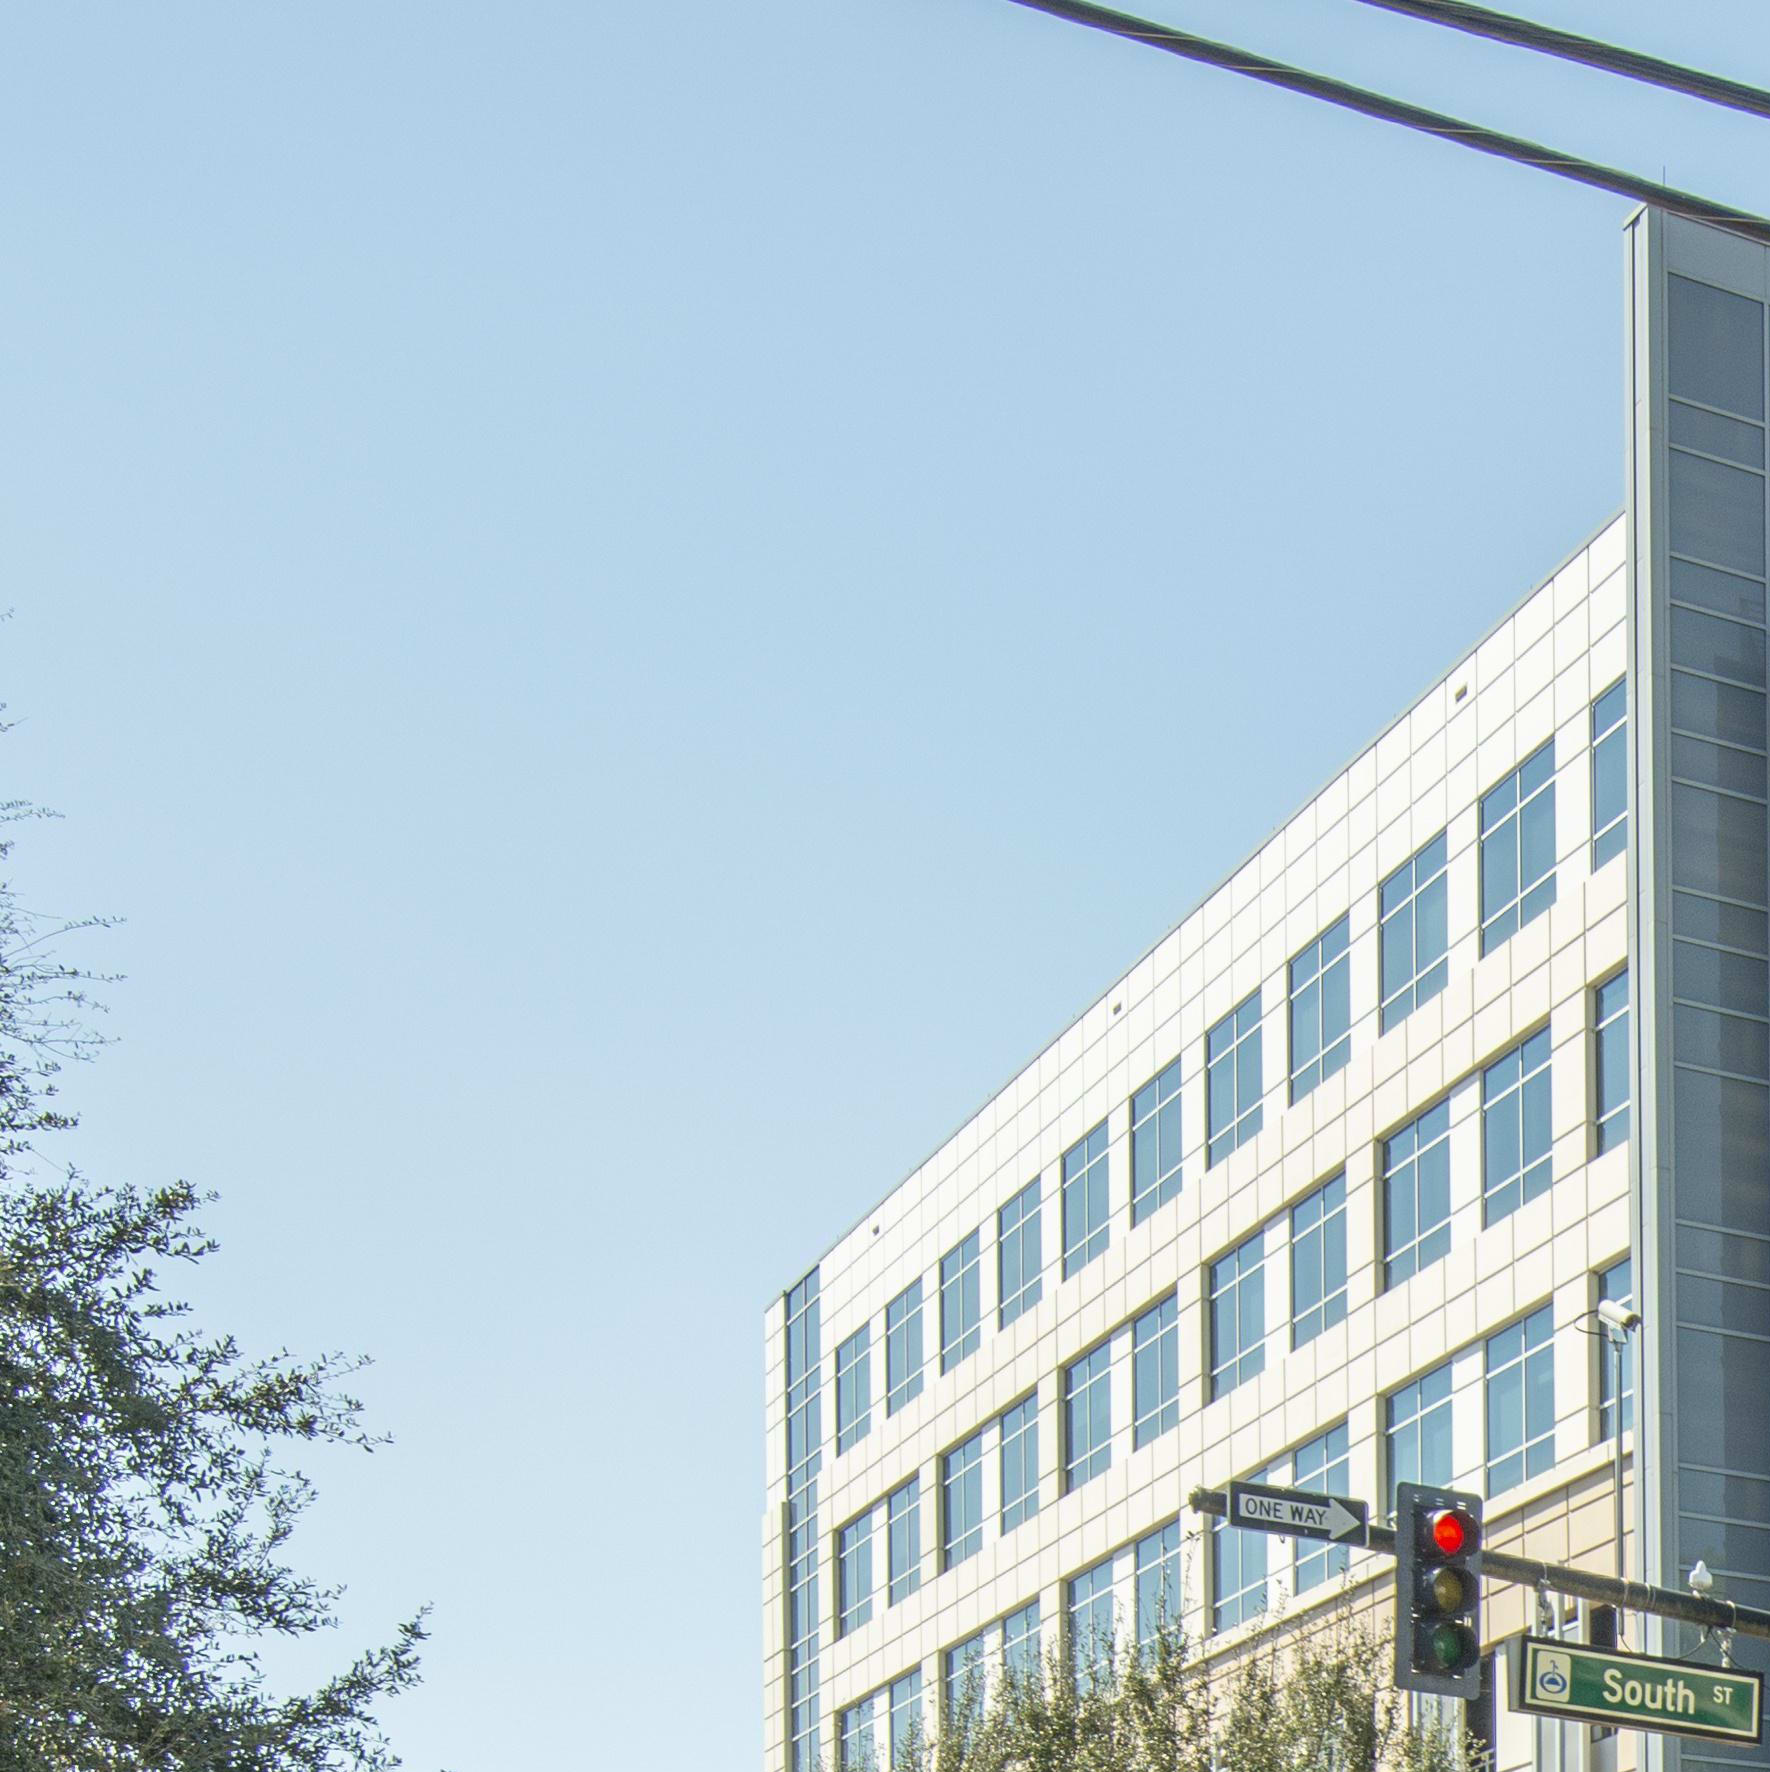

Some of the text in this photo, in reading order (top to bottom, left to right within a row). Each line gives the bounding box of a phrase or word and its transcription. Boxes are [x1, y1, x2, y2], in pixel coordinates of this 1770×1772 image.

[1245, 1497, 1327, 1526] ONE WAY
[1602, 1668, 1733, 1715] South ST
